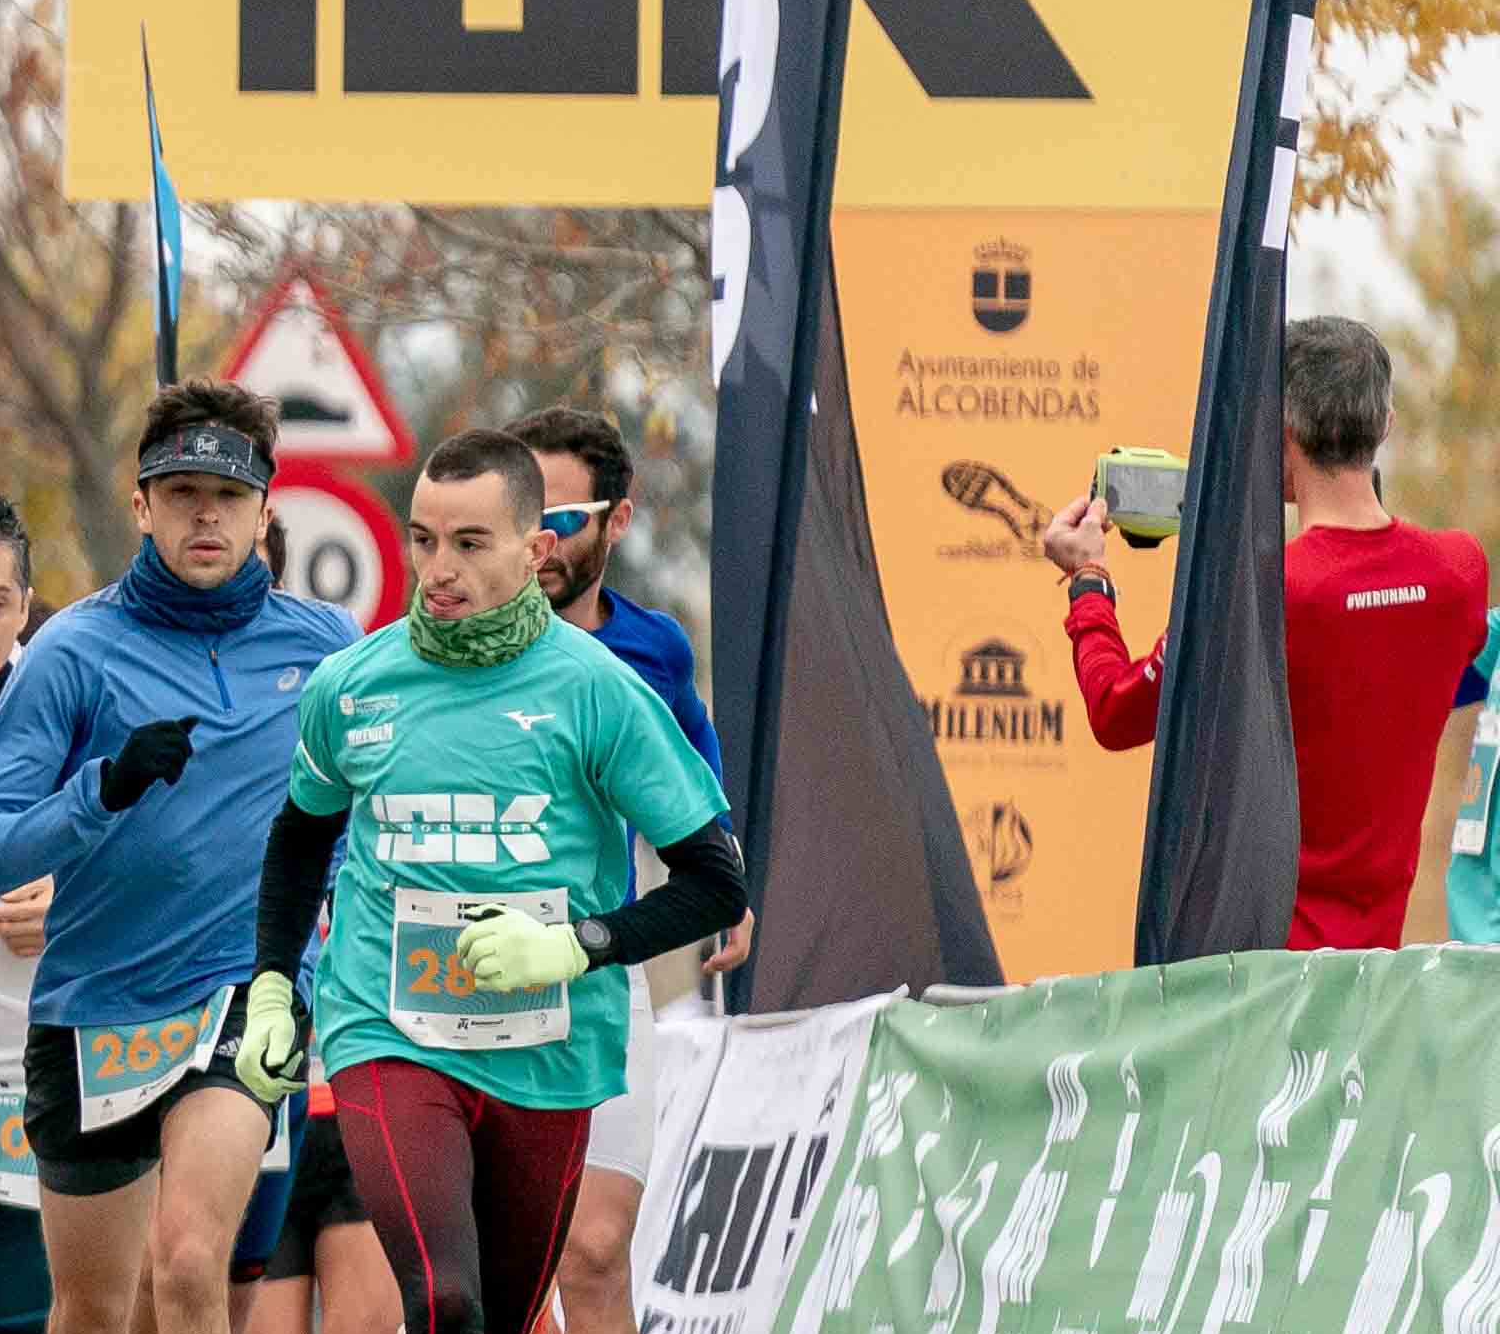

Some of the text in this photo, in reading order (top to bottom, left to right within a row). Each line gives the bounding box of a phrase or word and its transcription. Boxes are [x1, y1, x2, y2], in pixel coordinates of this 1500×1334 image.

[897, 347, 1061, 384] Ayuntamiento
[896, 385, 1102, 421] ALCOBENDAS
[1346, 584, 1428, 611] #WERUNMAD
[371, 794, 552, 864] 10K
